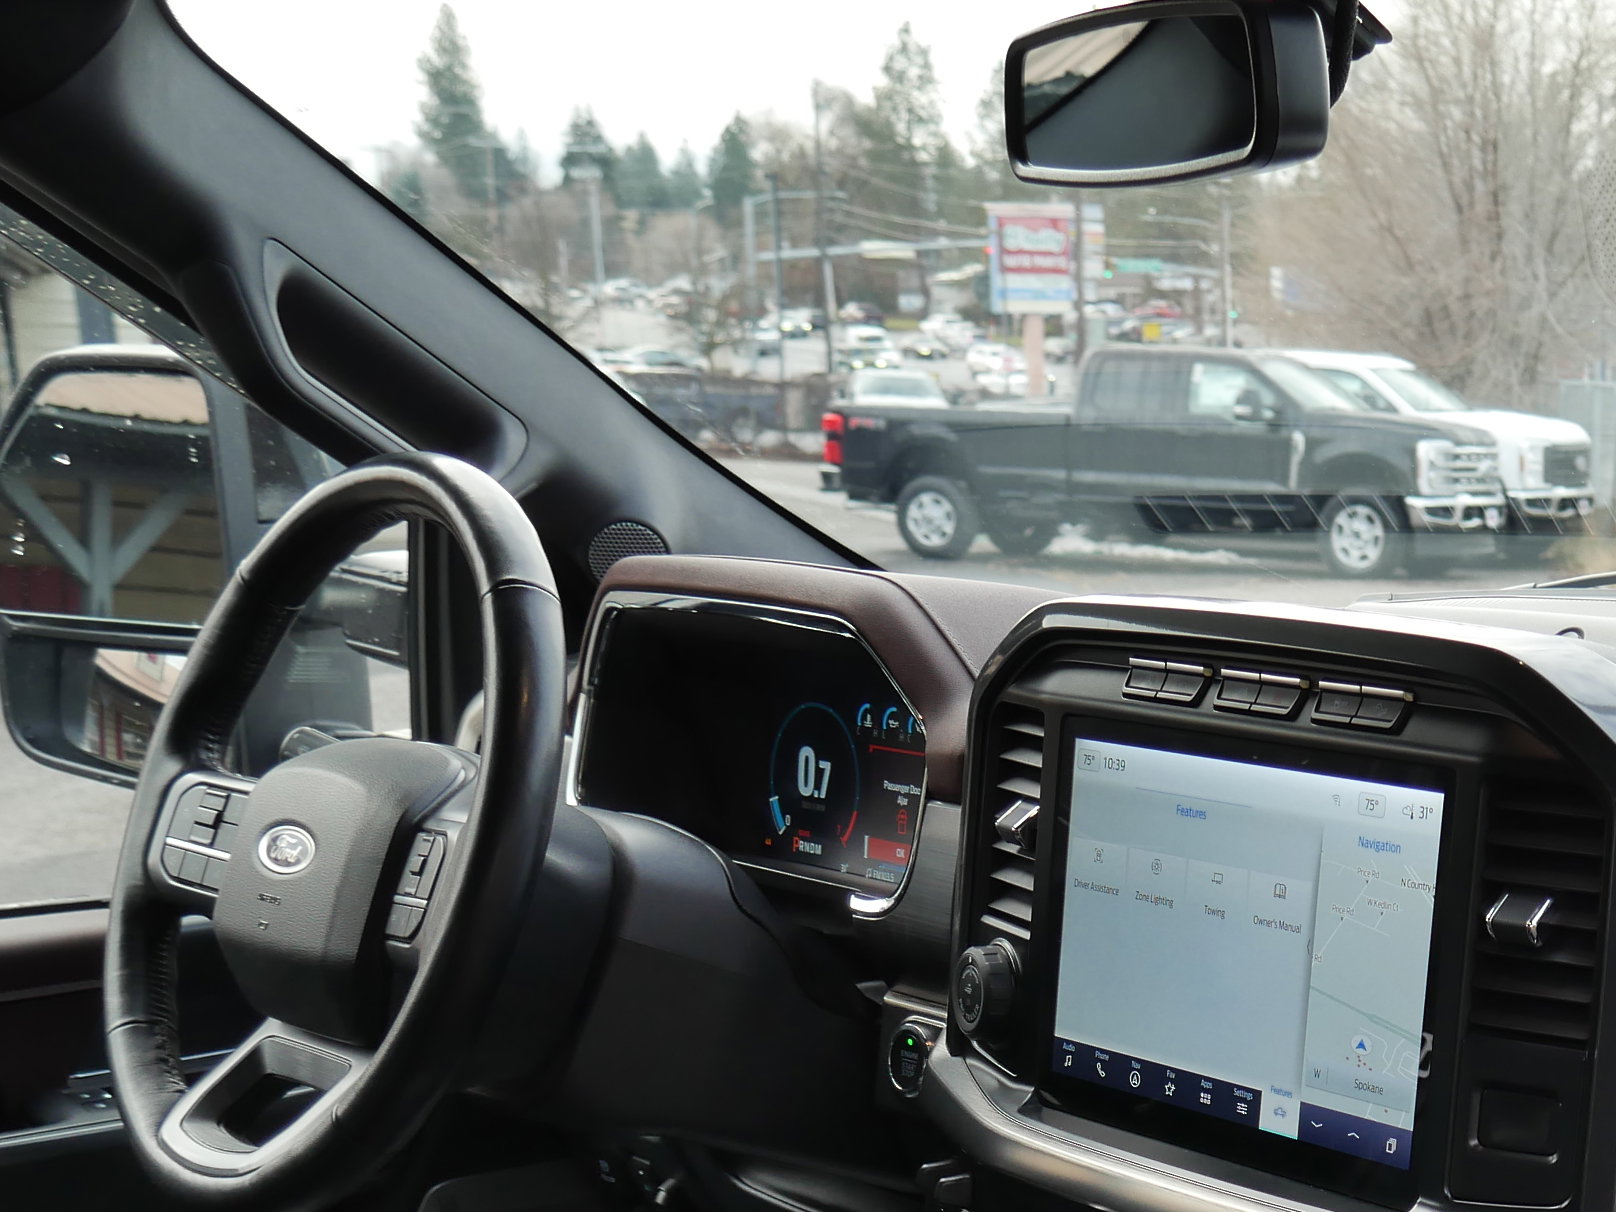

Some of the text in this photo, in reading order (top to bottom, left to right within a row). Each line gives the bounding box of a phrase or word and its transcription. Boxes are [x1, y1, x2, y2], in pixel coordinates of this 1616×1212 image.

[797, 745, 832, 799] 0.7
[1103, 756, 1126, 772] 10:39
[883, 779, 921, 796] Passenger Doo
[1176, 803, 1207, 820] Features
[1364, 798, 1434, 820] 75° 31°
[1358, 835, 1401, 854] Navigation
[896, 848, 905, 858] OK
[1357, 867, 1380, 879] Price Rd
[1074, 877, 1120, 897] Driver Assistance
[1401, 877, 1432, 894] N Country
[1135, 890, 1174, 909] Zone Lighting
[1204, 904, 1226, 920] Towing
[1331, 903, 1354, 915] Price Rd
[1253, 914, 1302, 934] Owner's Manual
[1062, 1041, 1076, 1053] Audio
[1095, 1050, 1110, 1062] Phone
[1131, 1060, 1142, 1069] Nav
[1166, 1069, 1176, 1079] Fav
[1313, 1068, 1321, 1079] W
[1200, 1079, 1213, 1090] Apps
[1270, 1084, 1293, 1099] Features
[1354, 1077, 1384, 1096] Spokane
[1233, 1086, 1254, 1101] Settings
